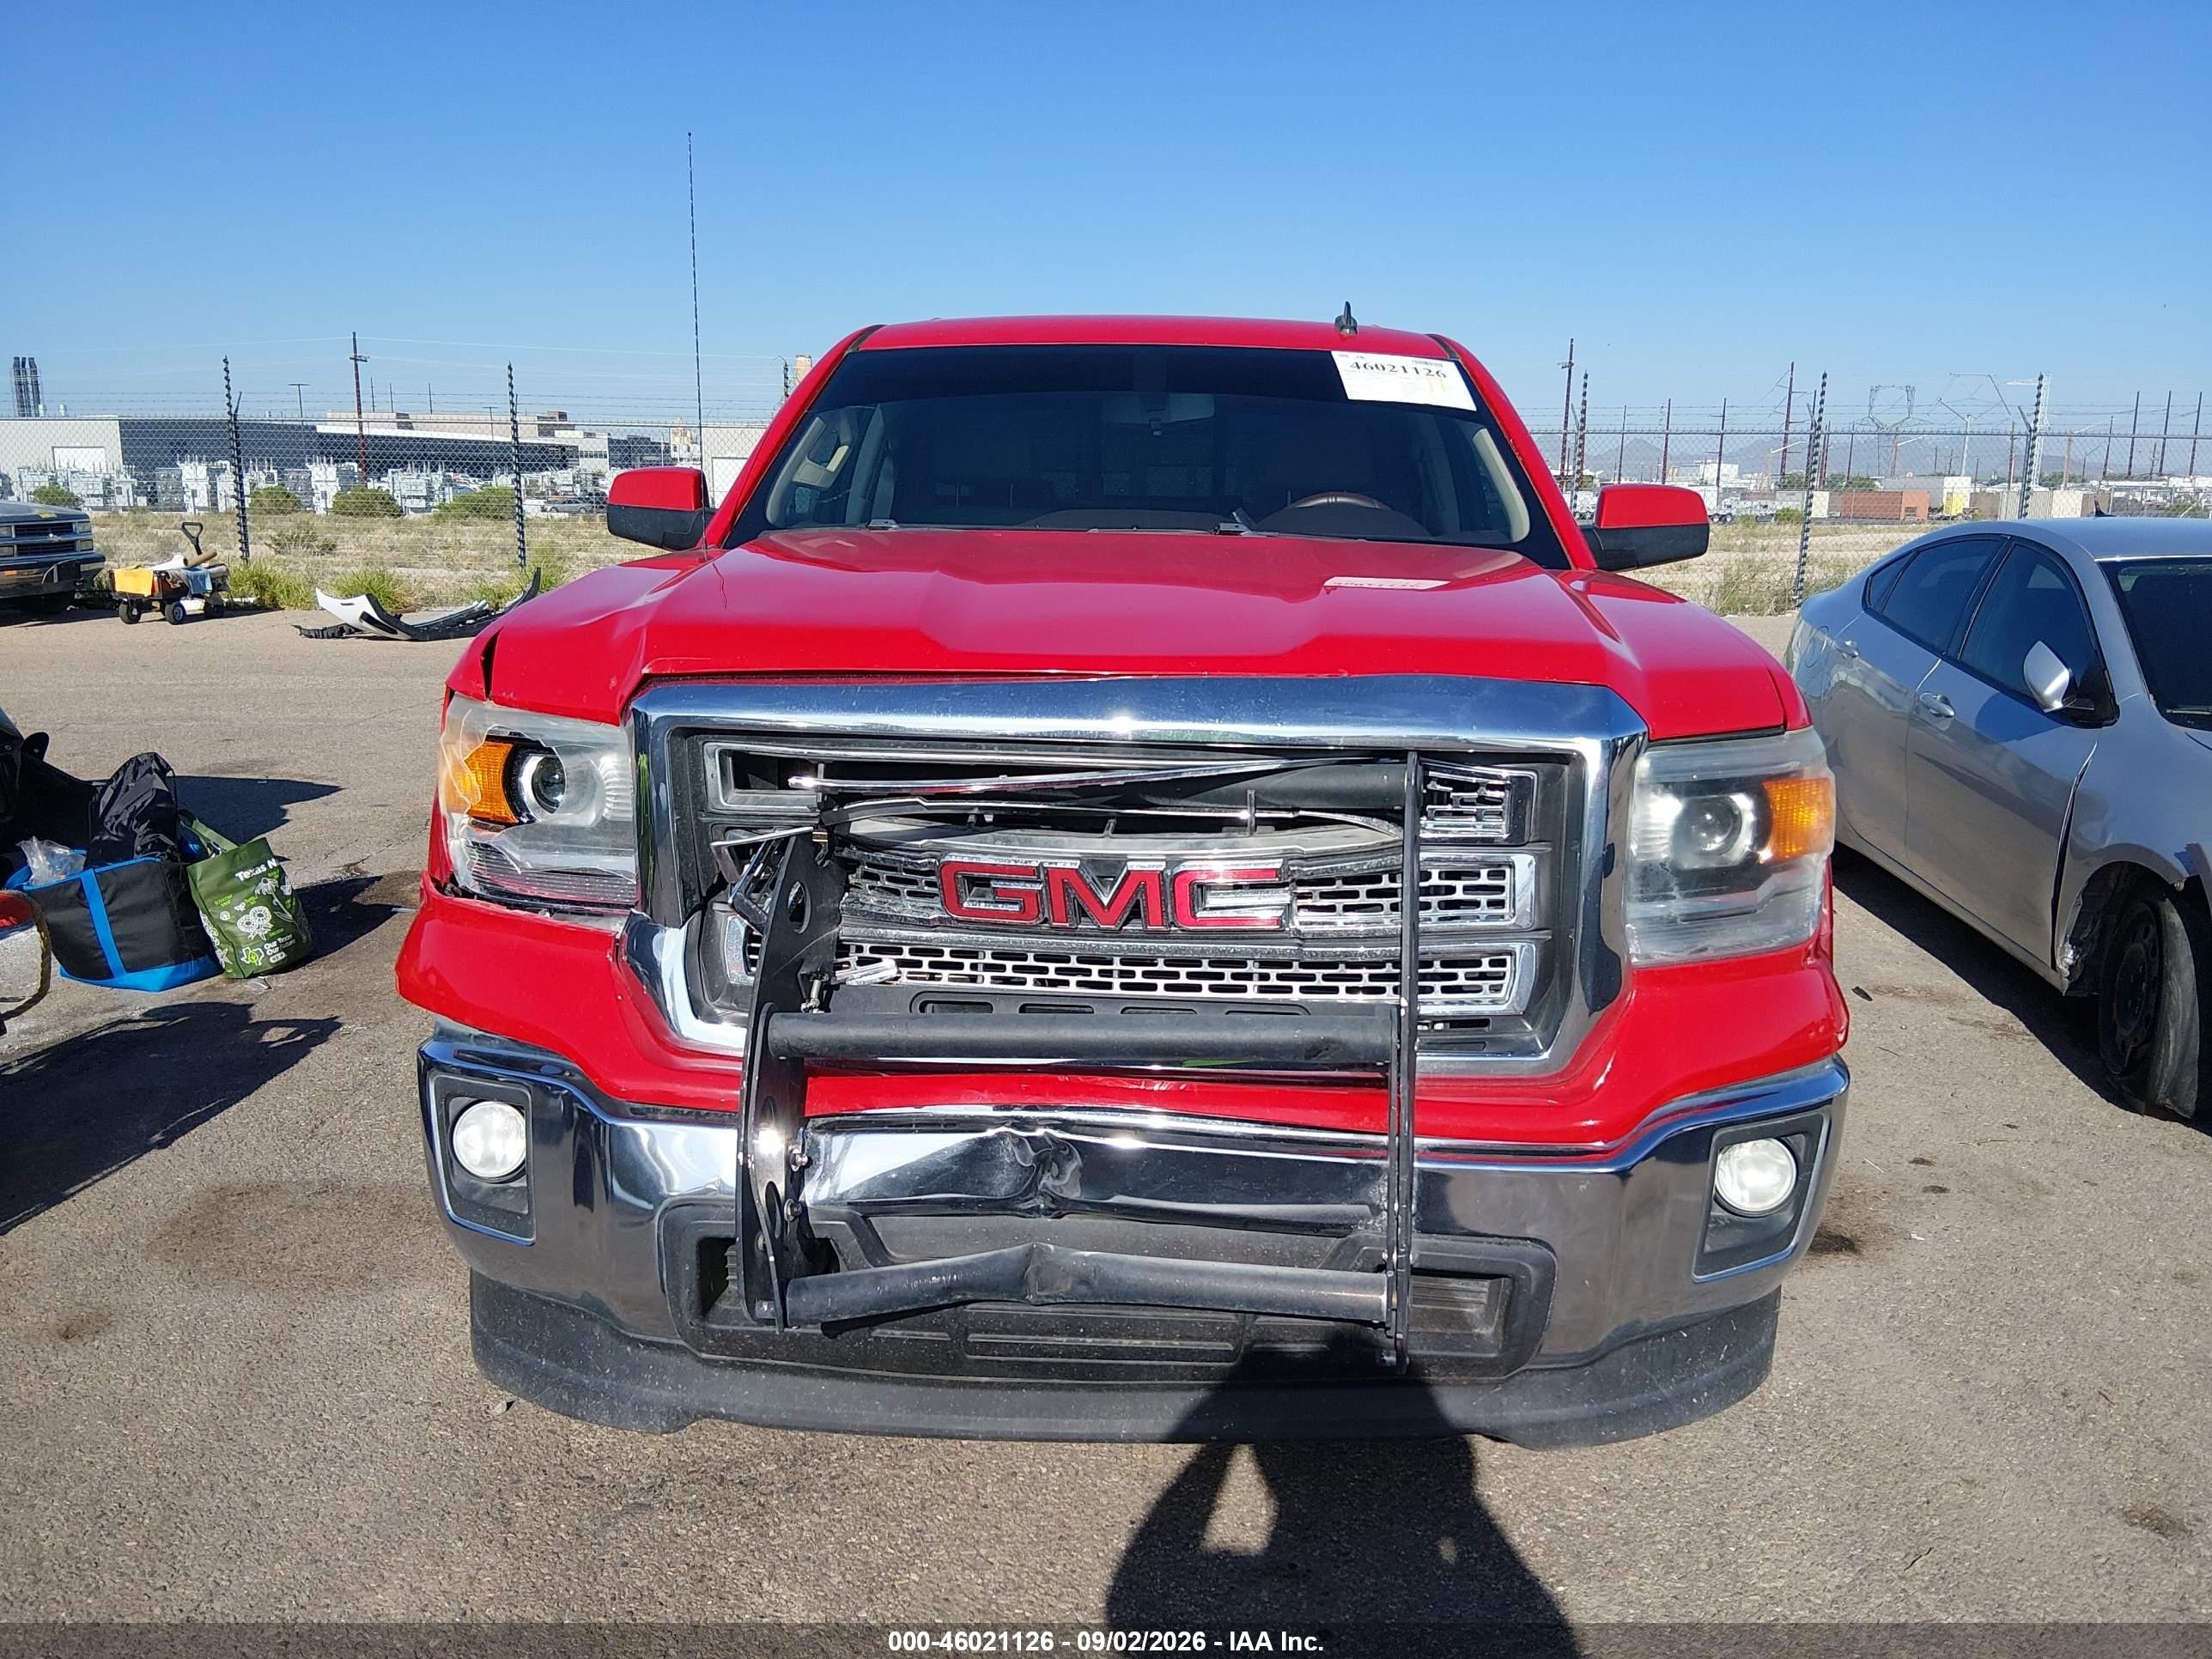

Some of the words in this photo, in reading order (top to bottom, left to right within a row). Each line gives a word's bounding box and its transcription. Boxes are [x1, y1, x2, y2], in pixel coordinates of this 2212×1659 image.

[1350, 361, 1447, 379] 46021126
[234, 864, 267, 881] Texas
[939, 854, 1287, 932] GMC
[264, 940, 277, 950] Our
[266, 946, 280, 956] Our
